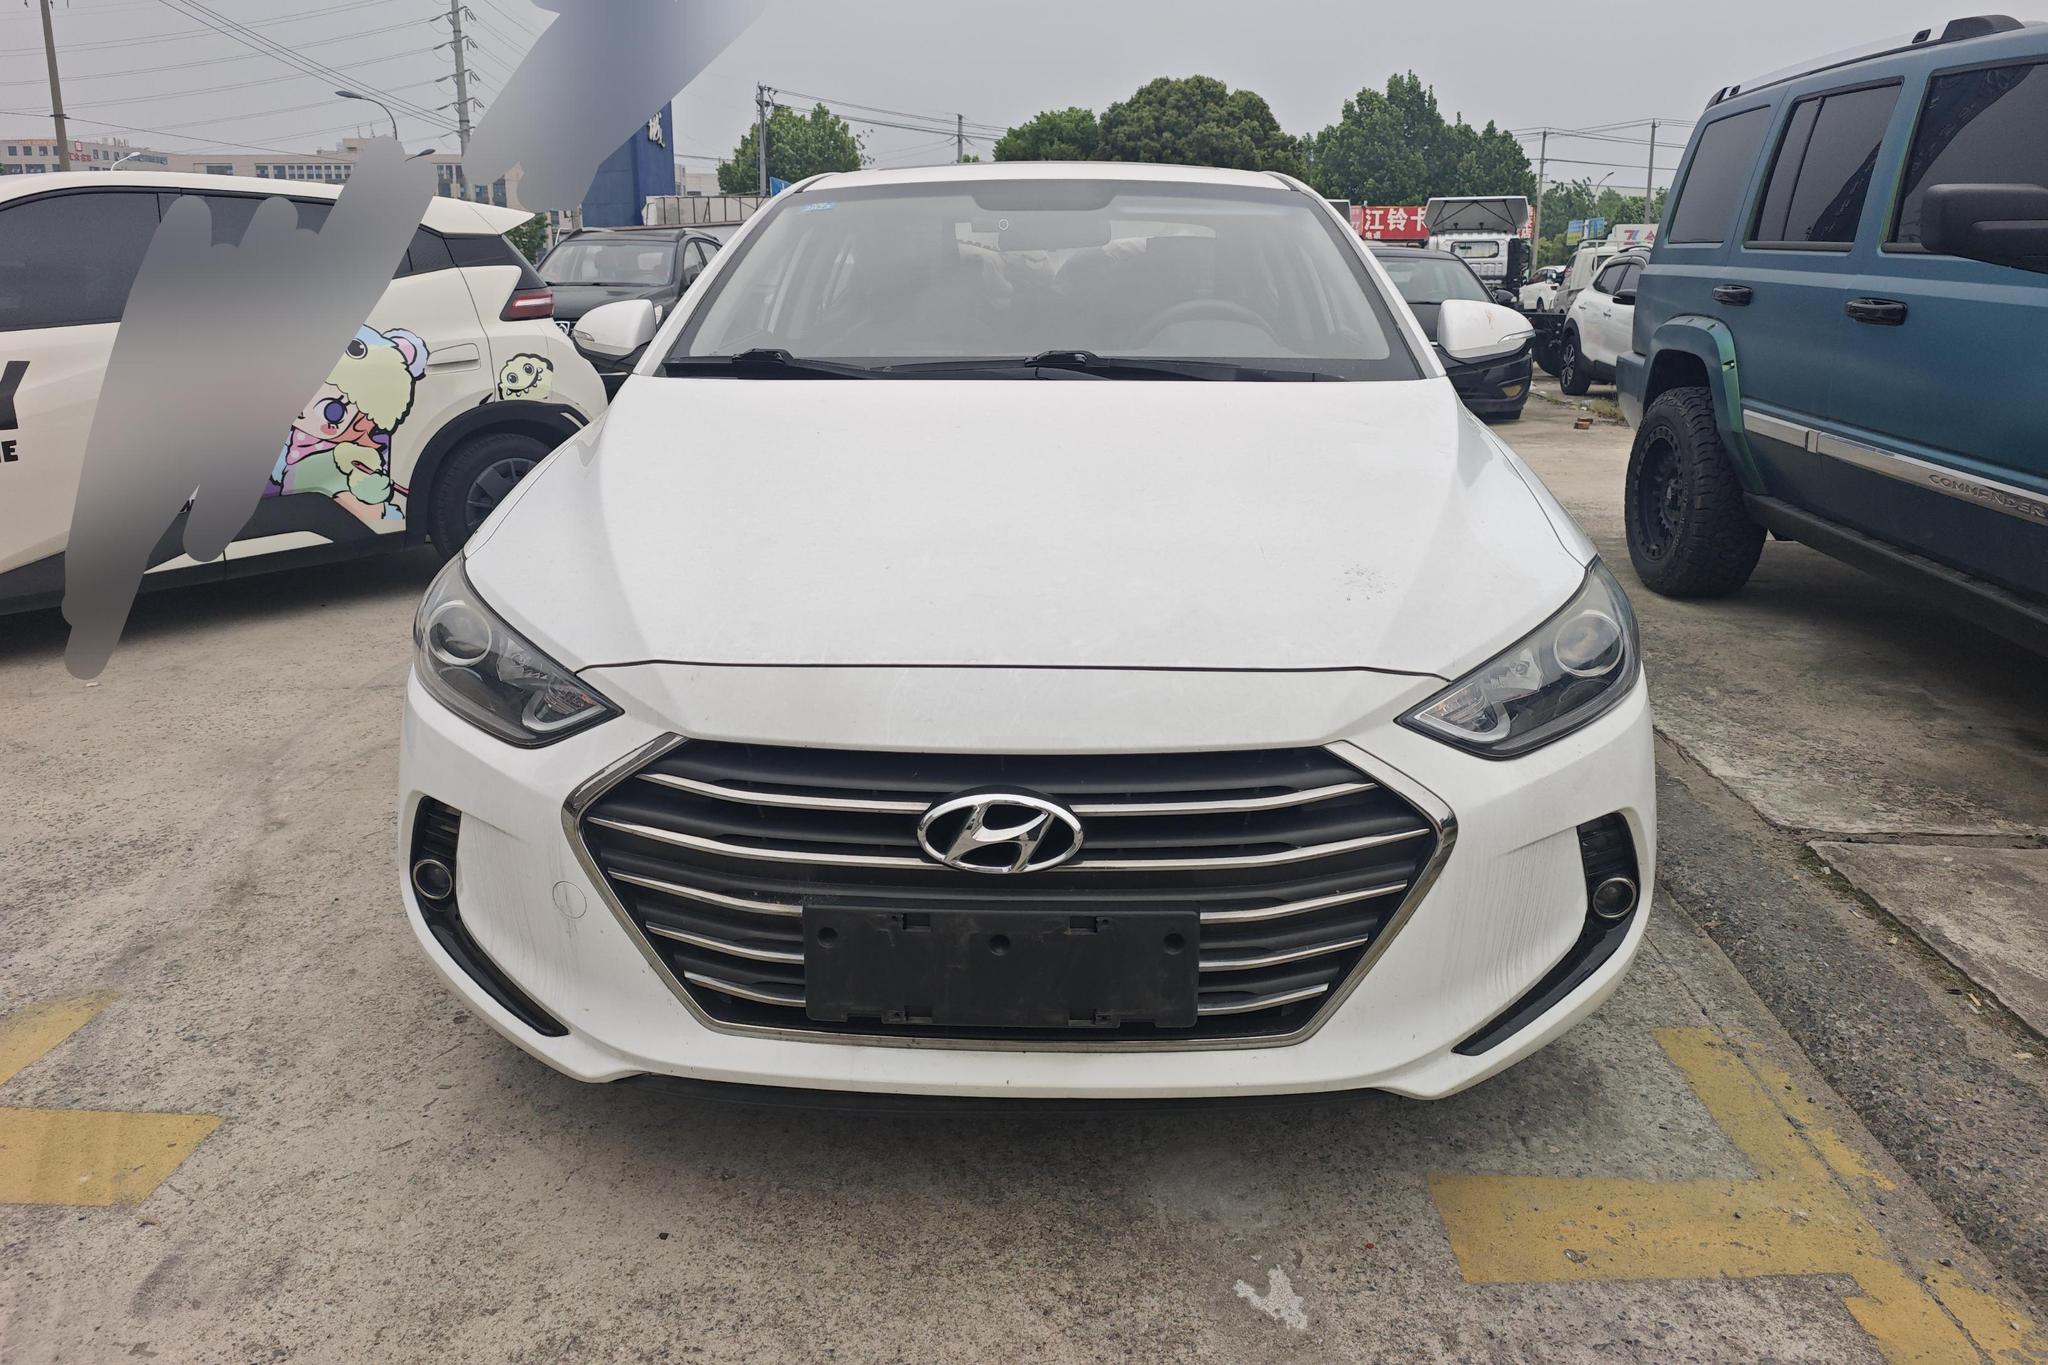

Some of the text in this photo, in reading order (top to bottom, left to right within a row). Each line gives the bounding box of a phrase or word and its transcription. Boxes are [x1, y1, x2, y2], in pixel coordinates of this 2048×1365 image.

[1364, 207, 1427, 232] 江铃卡
[1928, 474, 2048, 519] COMMANDER
